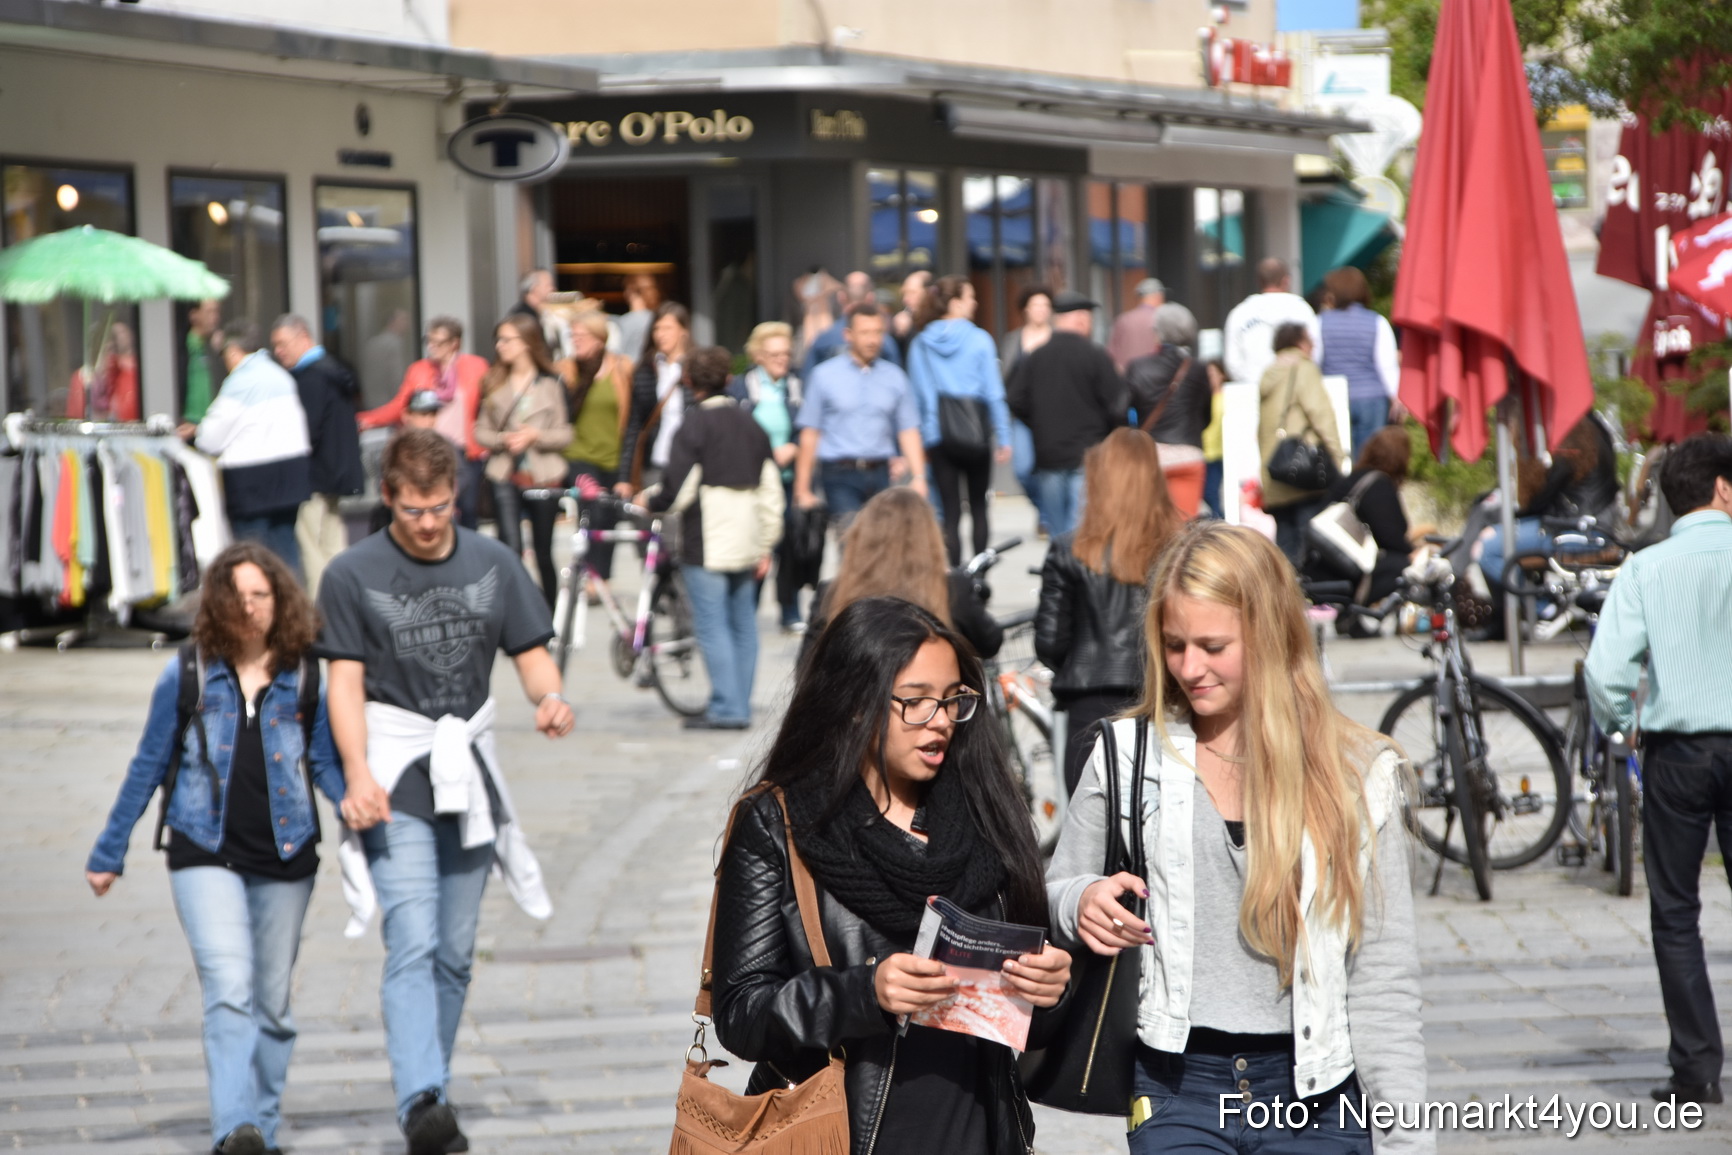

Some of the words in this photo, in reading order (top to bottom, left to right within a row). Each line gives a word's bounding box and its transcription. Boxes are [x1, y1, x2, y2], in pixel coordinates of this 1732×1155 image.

[619, 108, 754, 146] O'Polo
[951, 939, 963, 948] und
[963, 943, 994, 952] sichtbare
